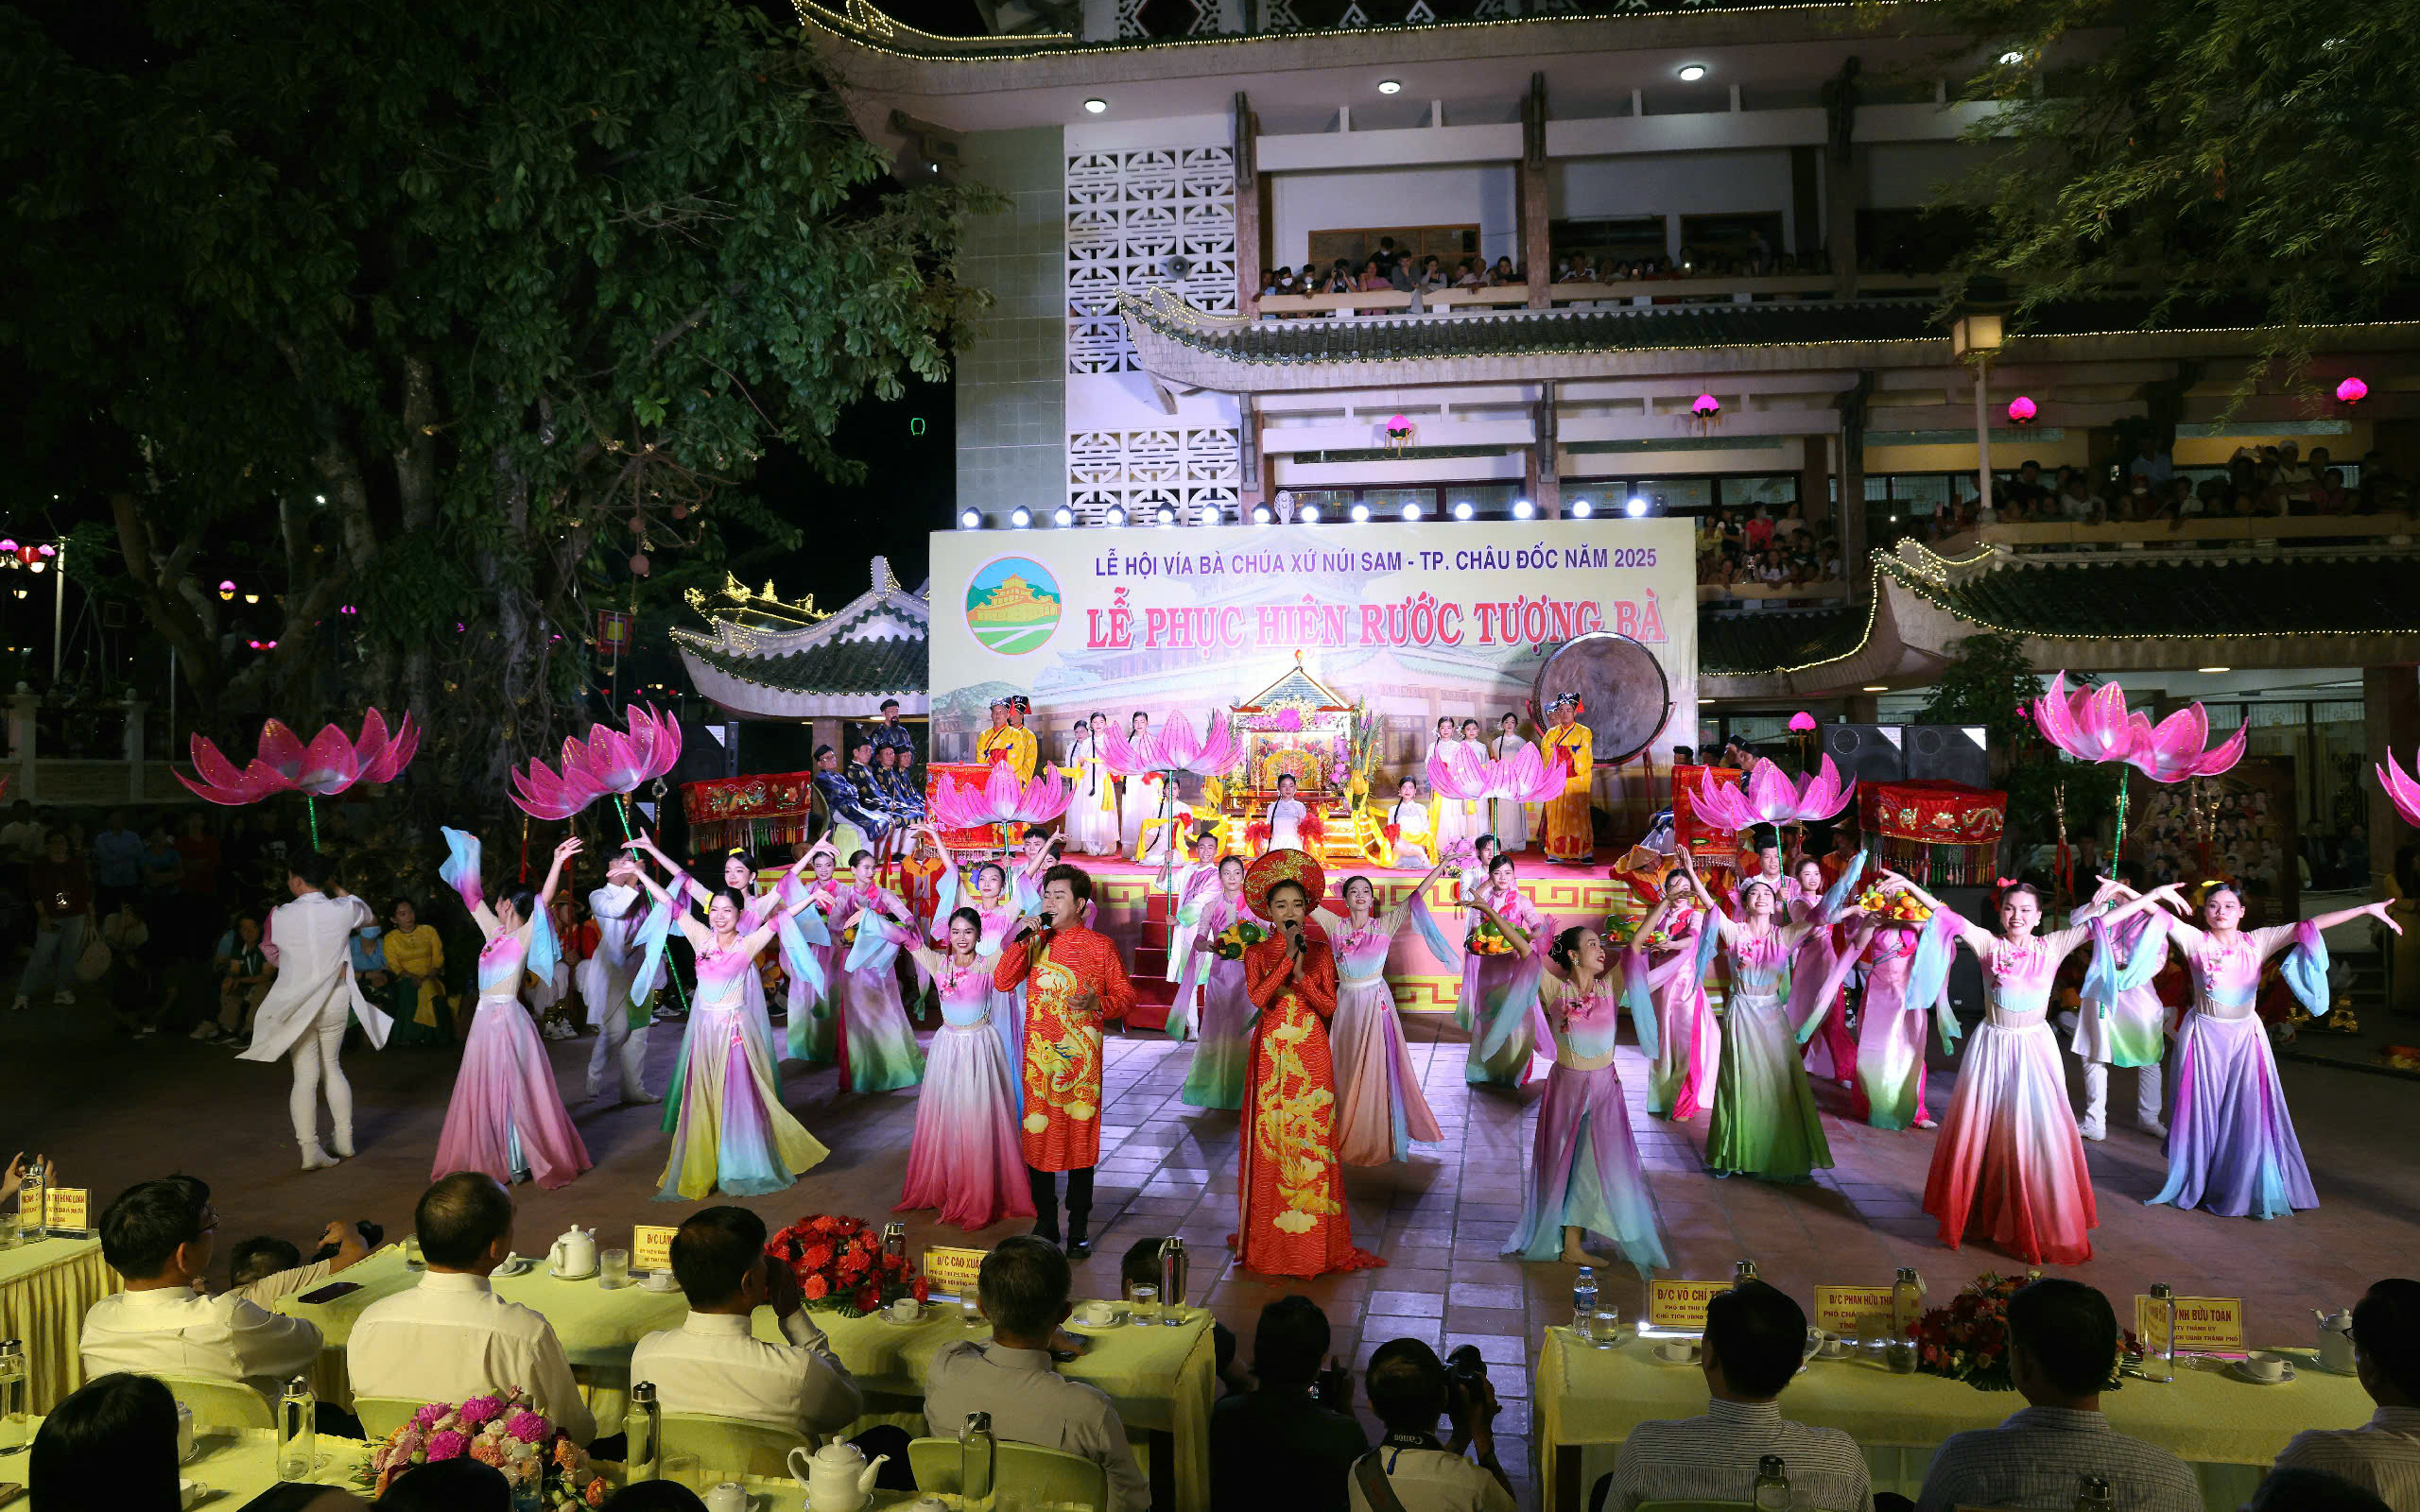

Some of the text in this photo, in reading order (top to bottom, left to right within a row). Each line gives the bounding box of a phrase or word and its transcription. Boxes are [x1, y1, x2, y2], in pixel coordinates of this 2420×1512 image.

[1096, 548, 1118, 576] LỄ
[1125, 551, 1157, 579] HỘI
[1164, 551, 1193, 576] VÍA
[1200, 550, 1225, 575] BÀ
[1232, 549, 1285, 574] CHÚA
[1290, 548, 1317, 573] XỨ
[1322, 548, 1355, 573] NÚI
[1361, 551, 1402, 572] SAM
[1420, 551, 1449, 571] TP.
[1456, 545, 1510, 571] CHÂU
[1516, 541, 1558, 569] ĐỐC
[1564, 543, 1608, 568] NĂM
[1614, 548, 1657, 568] 2025
[1086, 586, 1669, 660] LỄ PHỤC HIỆN RƯỚC TƯỢNG BÀ
[951, 1256, 964, 1268] CAO
[965, 1256, 982, 1269] XUÂ
[1657, 1288, 1675, 1301] Đ/C
[1676, 1287, 1689, 1301] VÕ
[1692, 1287, 1708, 1301] CHÍ
[1829, 1294, 1842, 1305] Đ/C
[1844, 1295, 1862, 1305] PHAN
[1863, 1293, 1878, 1306] HỮU
[1393, 1434, 1425, 1445] Canon
